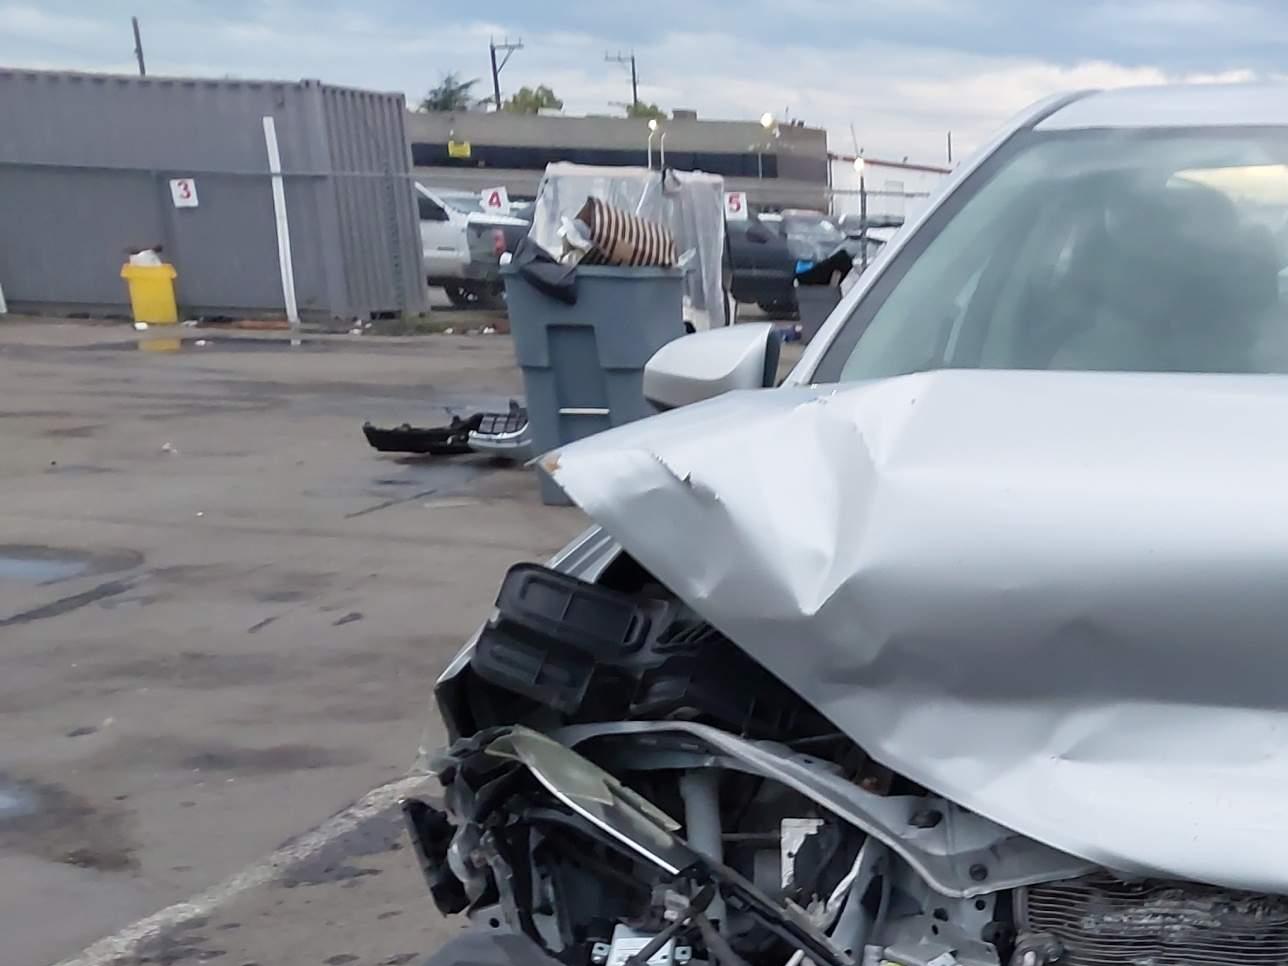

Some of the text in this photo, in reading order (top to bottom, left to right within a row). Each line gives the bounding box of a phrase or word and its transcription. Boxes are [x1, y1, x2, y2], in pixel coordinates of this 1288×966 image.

[177, 181, 191, 199] 3
[488, 191, 501, 208] 4
[729, 193, 741, 212] 5
